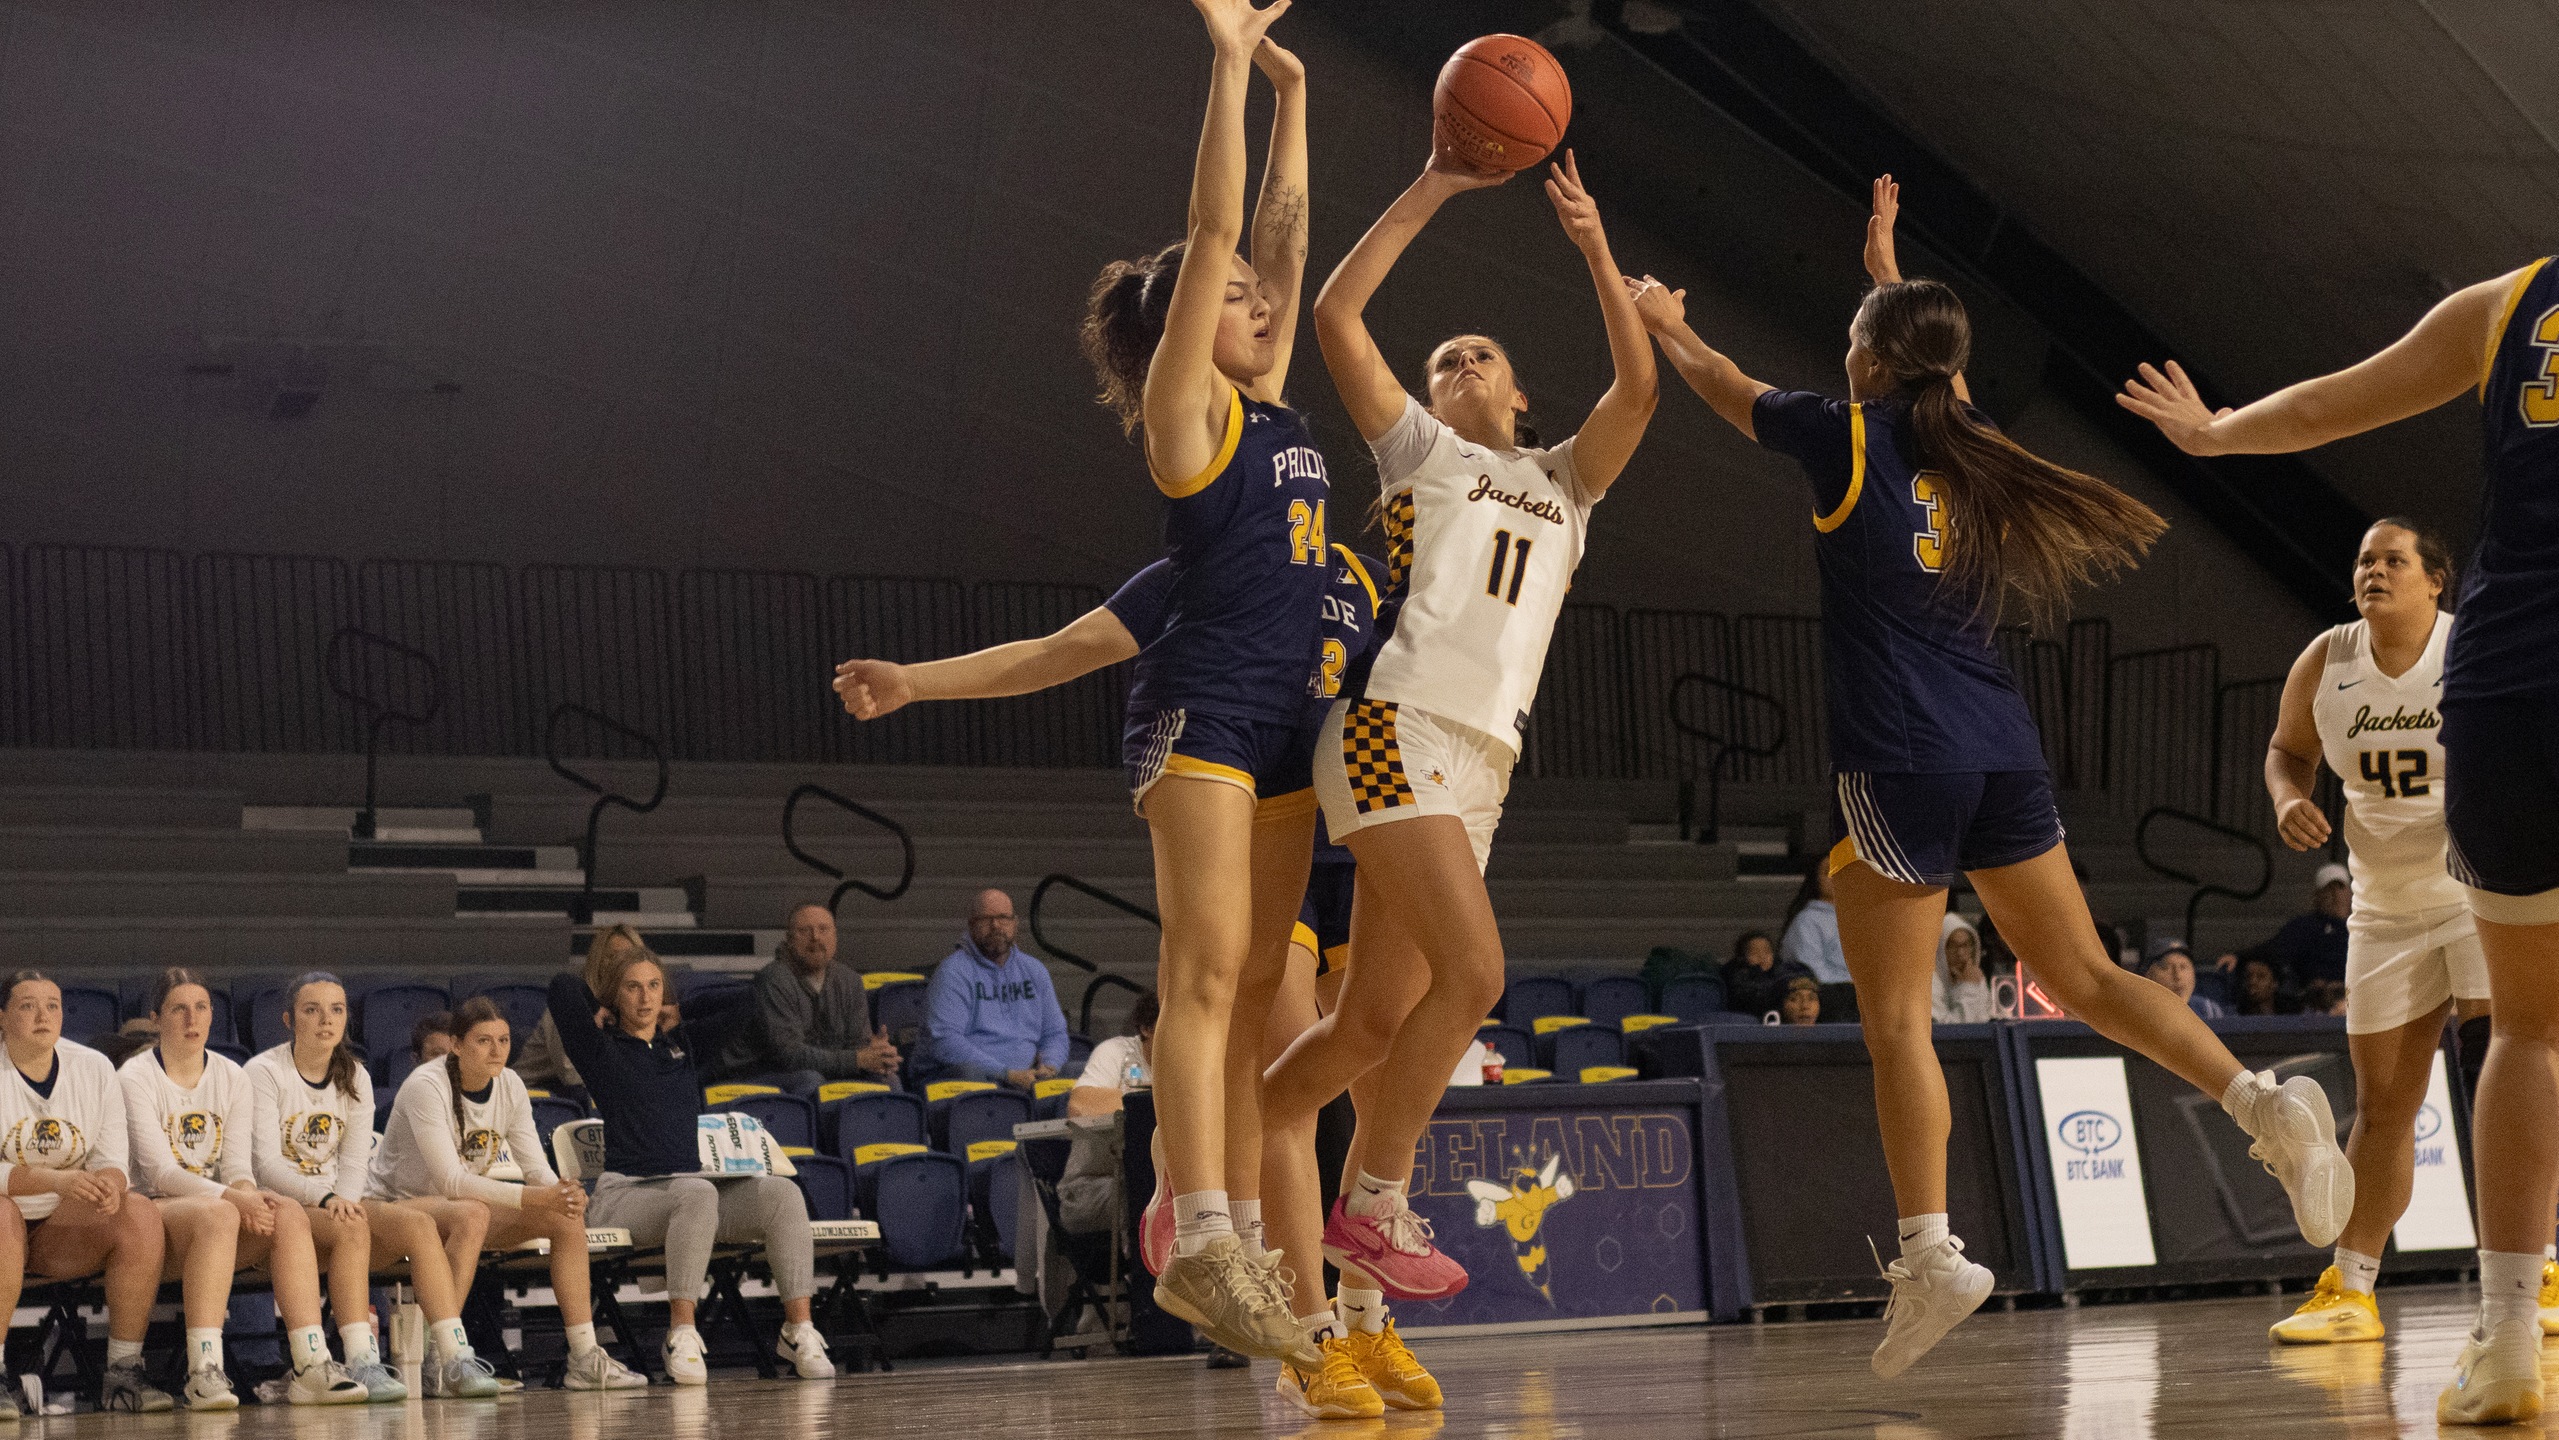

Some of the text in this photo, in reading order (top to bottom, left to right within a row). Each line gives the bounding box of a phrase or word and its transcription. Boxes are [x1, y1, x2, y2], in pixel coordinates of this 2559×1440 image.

[1467, 473, 1565, 525] Jackets
[1911, 469, 1958, 573] 3
[1287, 499, 1327, 567] 24
[1485, 527, 1534, 608] 11
[1315, 637, 1346, 698] 2
[2347, 704, 2440, 739] Jackets
[2359, 749, 2430, 799] 42
[587, 1128, 603, 1141] BT
[2076, 1119, 2105, 1142] BTC
[2067, 1159, 2125, 1180] BTC BANK
[811, 1226, 869, 1237] LLOWJACKETS
